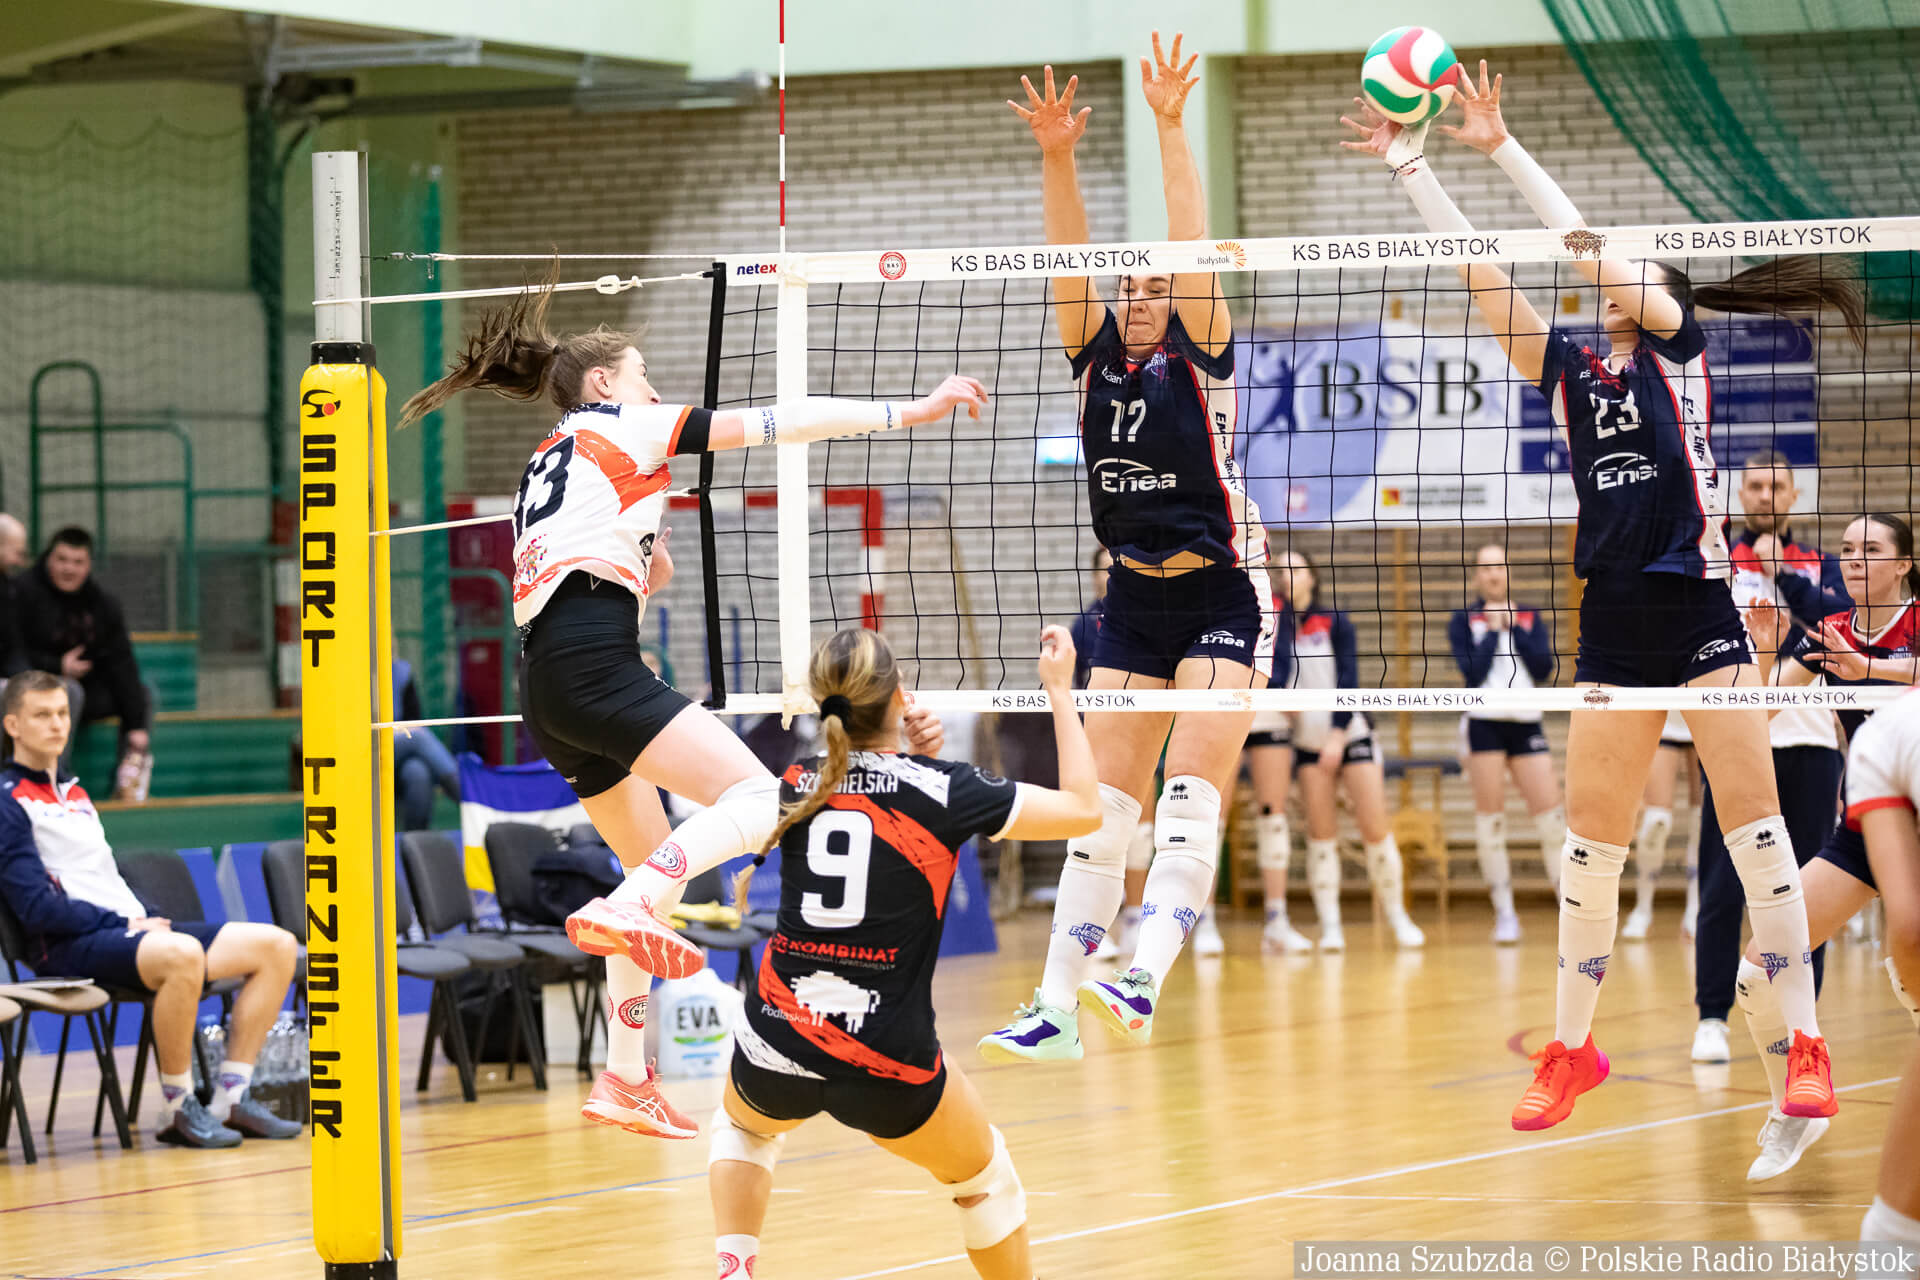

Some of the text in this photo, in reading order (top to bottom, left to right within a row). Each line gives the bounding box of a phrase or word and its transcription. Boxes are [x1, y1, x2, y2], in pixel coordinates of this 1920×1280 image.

[1656, 225, 1872, 250] KS BAS BIAŁYSTOK
[1197, 255, 1231, 266] Białystok
[1293, 238, 1500, 261] KS BAS BIAŁYSTOK
[737, 263, 777, 276] netex
[951, 250, 1151, 272] KS BAS BIAŁYSTOK
[1319, 358, 1484, 421] BSB
[1589, 389, 1642, 440] 23
[1100, 471, 1177, 493] Enea
[1200, 634, 1246, 648] Enea
[992, 695, 1012, 708] KS
[1016, 695, 1047, 708] BAS
[1336, 693, 1486, 706] KS BAS BIAŁYSTOK
[1701, 691, 1857, 706] KS BAS BIAŁYSTOK
[302, 434, 342, 1138] SPORT TRANSFER
[800, 810, 875, 928] 9
[789, 940, 899, 963] KOMBINAT
[676, 1004, 721, 1031] EVA
[760, 1003, 811, 1025] Podlaskie
